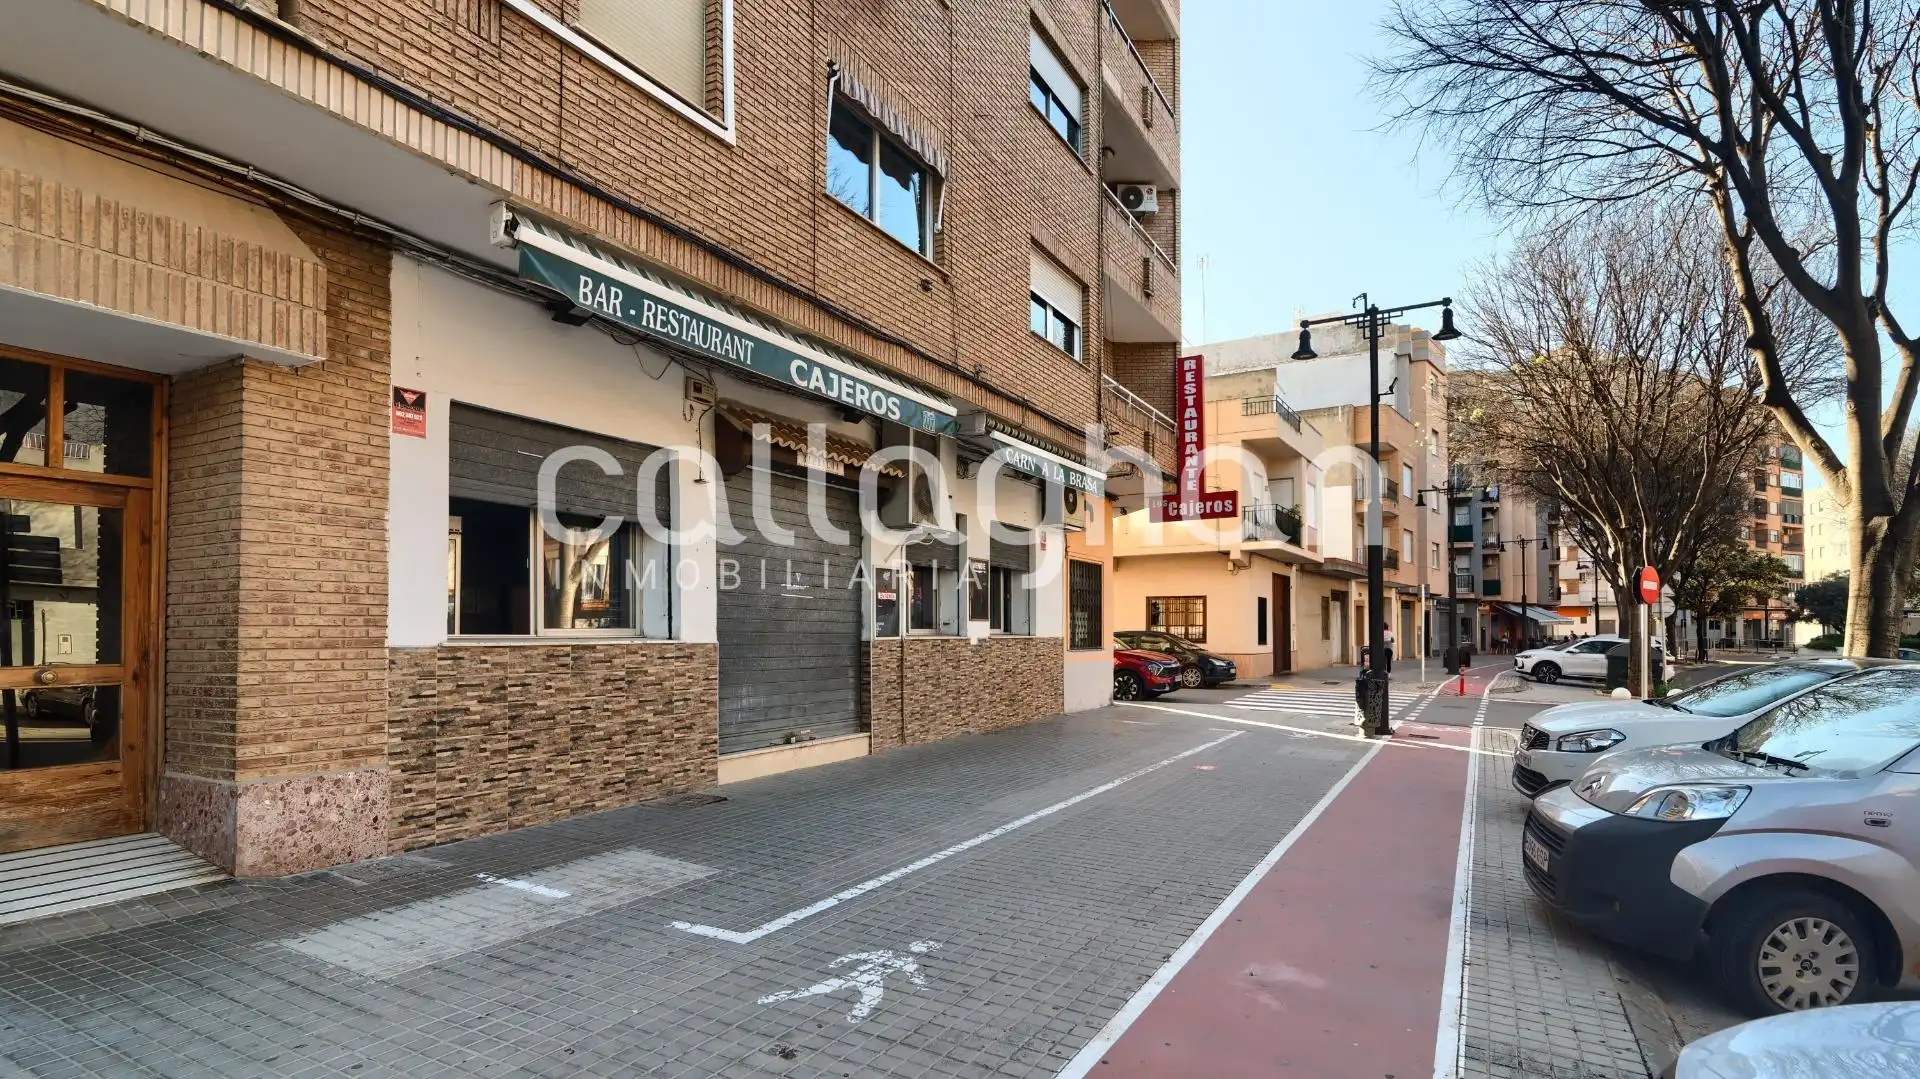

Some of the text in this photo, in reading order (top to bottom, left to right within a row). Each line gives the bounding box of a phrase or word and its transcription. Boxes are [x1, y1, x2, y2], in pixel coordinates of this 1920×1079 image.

[578, 274, 623, 318] BAR
[641, 298, 755, 365] RESTAURANT
[789, 359, 901, 421] CAJEROS
[1183, 359, 1198, 491] RESTAURANTE
[1005, 448, 1098, 494] CARN A LA BRASA
[1168, 500, 1233, 517] Cajeros
